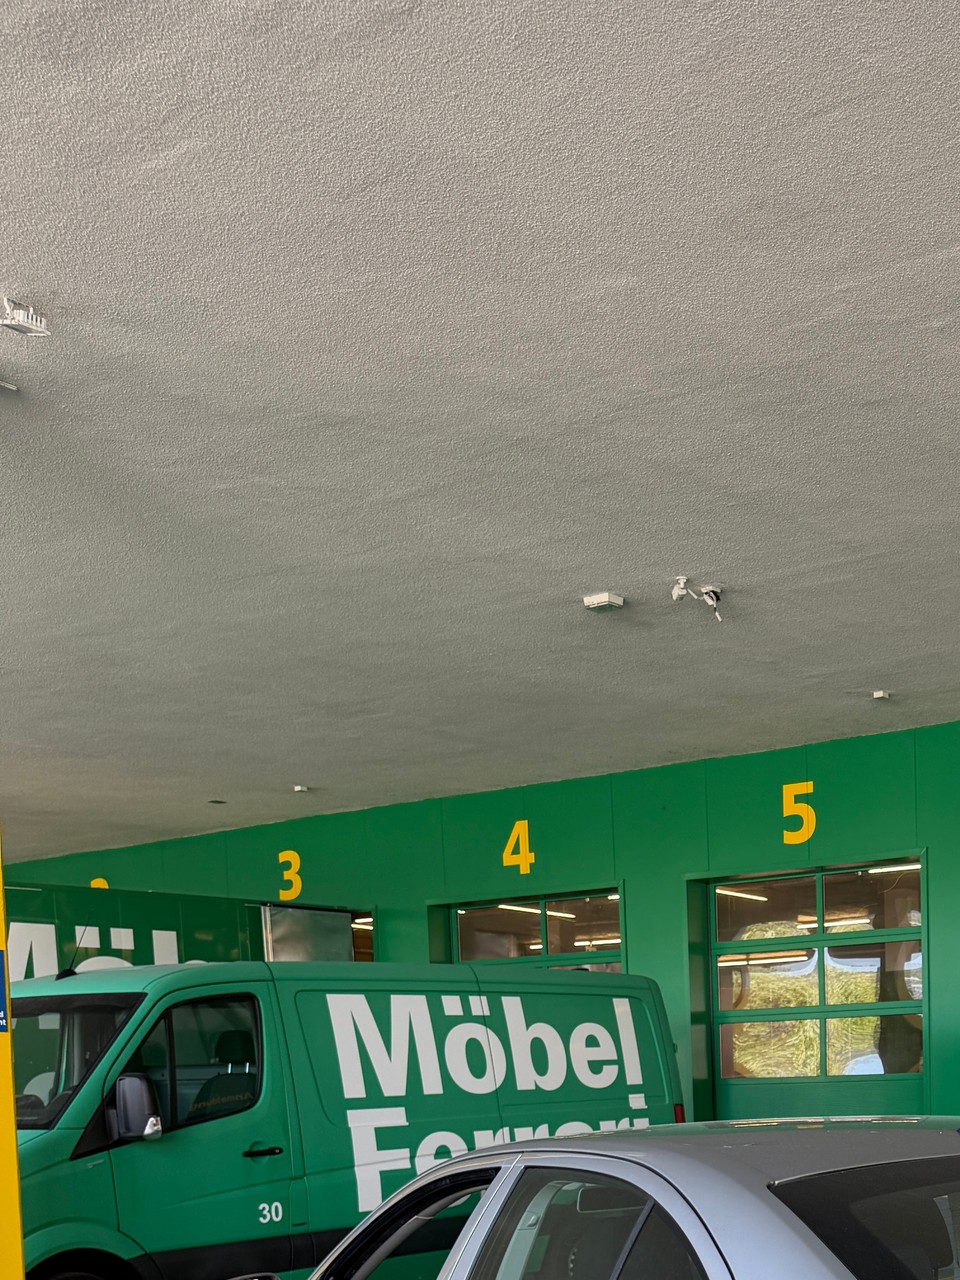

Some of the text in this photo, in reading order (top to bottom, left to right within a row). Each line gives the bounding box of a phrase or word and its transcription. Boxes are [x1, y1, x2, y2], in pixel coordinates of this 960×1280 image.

[782, 781, 816, 845] 5
[502, 820, 535, 875] 4
[278, 850, 302, 901] 3
[326, 994, 643, 1099] Möbel
[258, 1201, 283, 1223] 30
